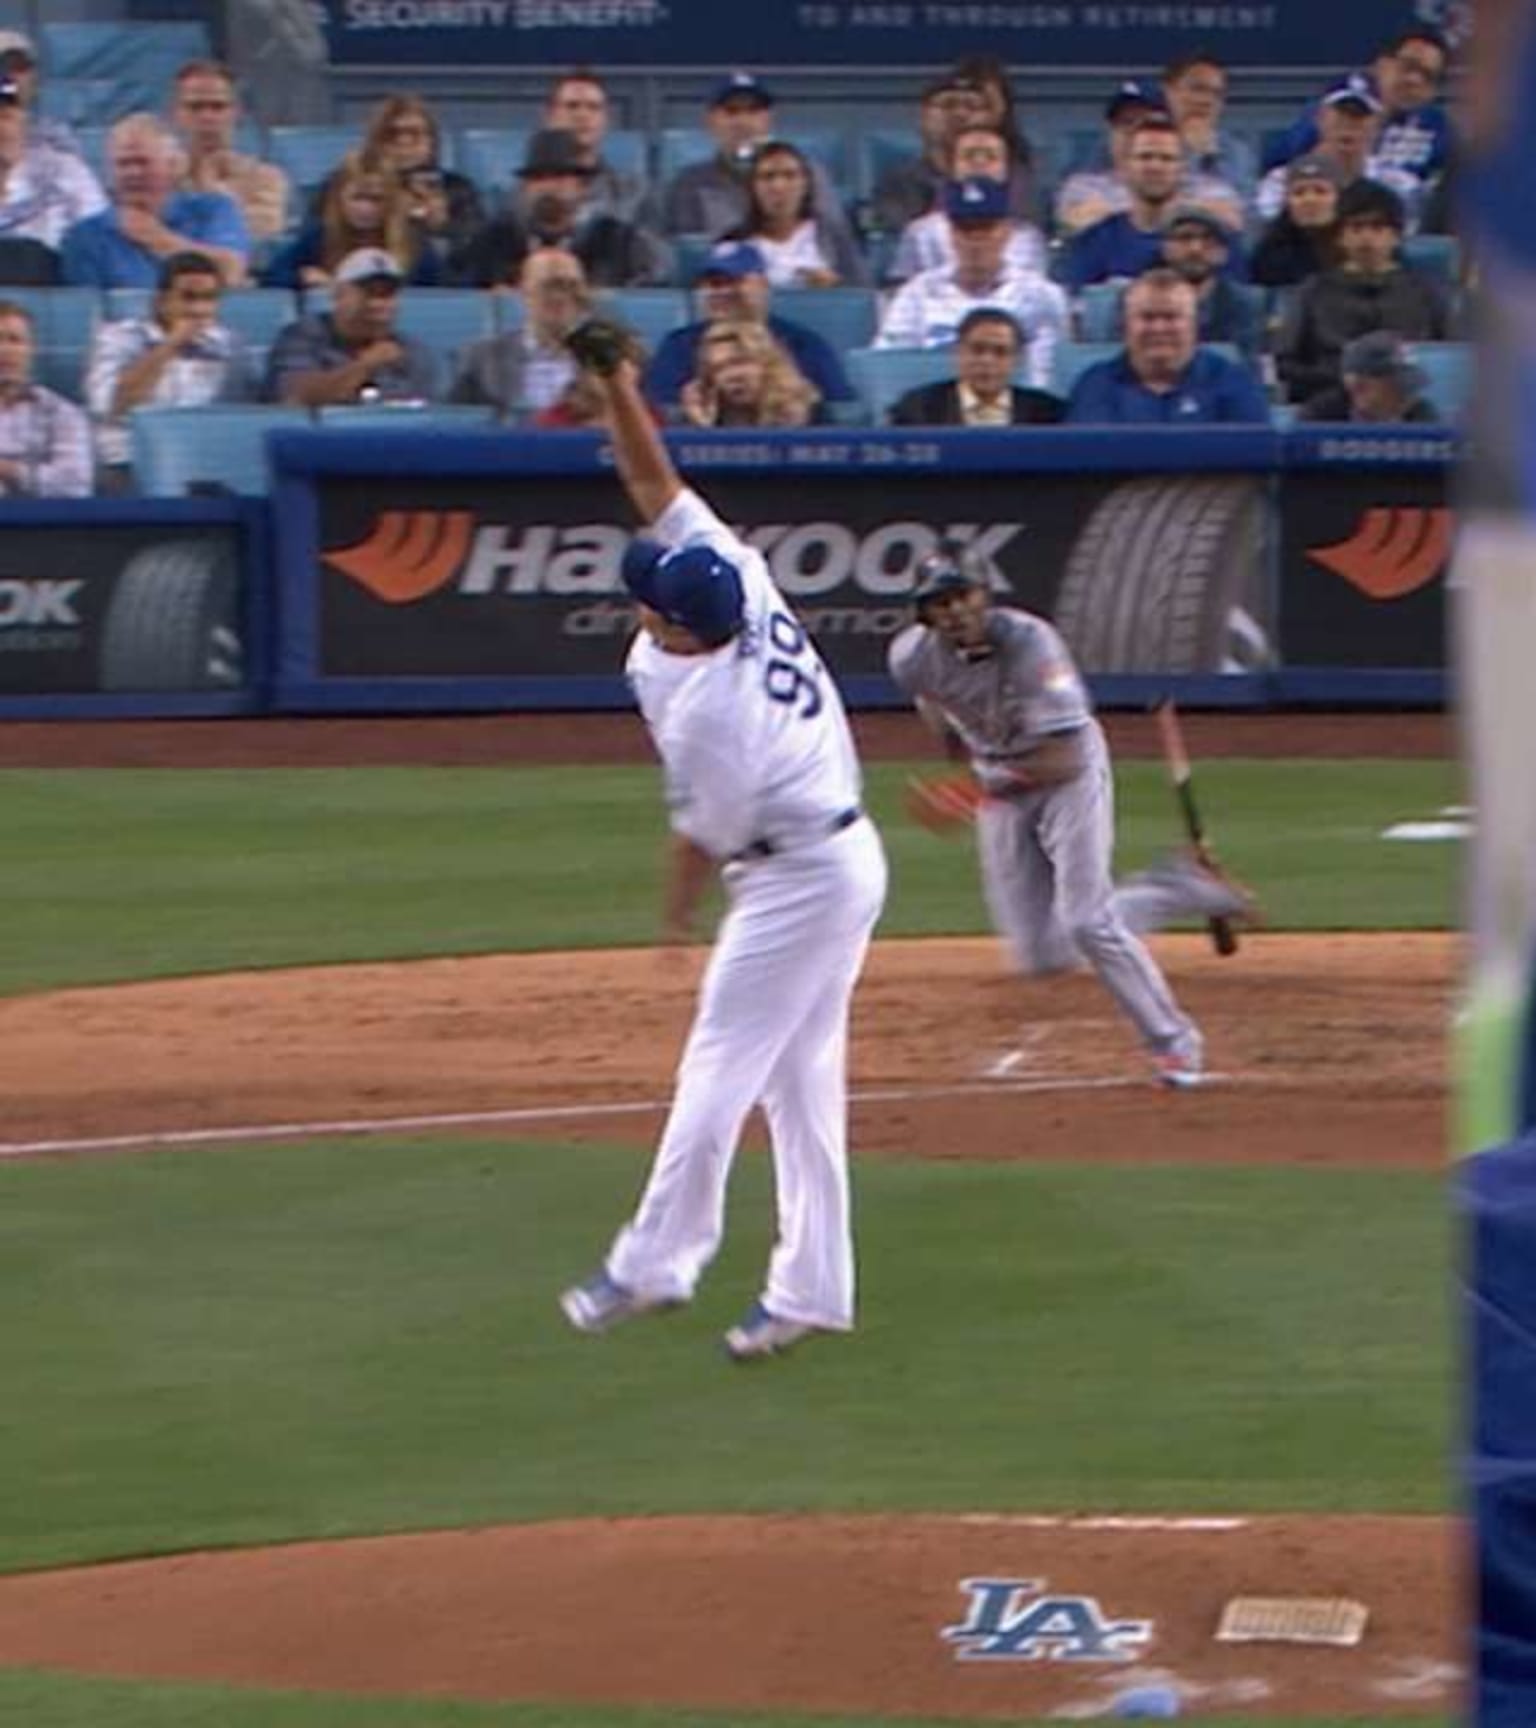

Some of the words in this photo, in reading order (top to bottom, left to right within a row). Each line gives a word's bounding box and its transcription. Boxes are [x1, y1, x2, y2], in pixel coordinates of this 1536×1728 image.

[346, 0, 508, 28] SECURITY
[515, 0, 657, 28] BENEFIT
[799, 5, 838, 26] TO
[850, 5, 912, 25] AND
[925, 5, 1071, 26] THROUGH
[1083, 6, 1275, 27] RETIREMENT
[941, 1577, 1152, 1661] LA
